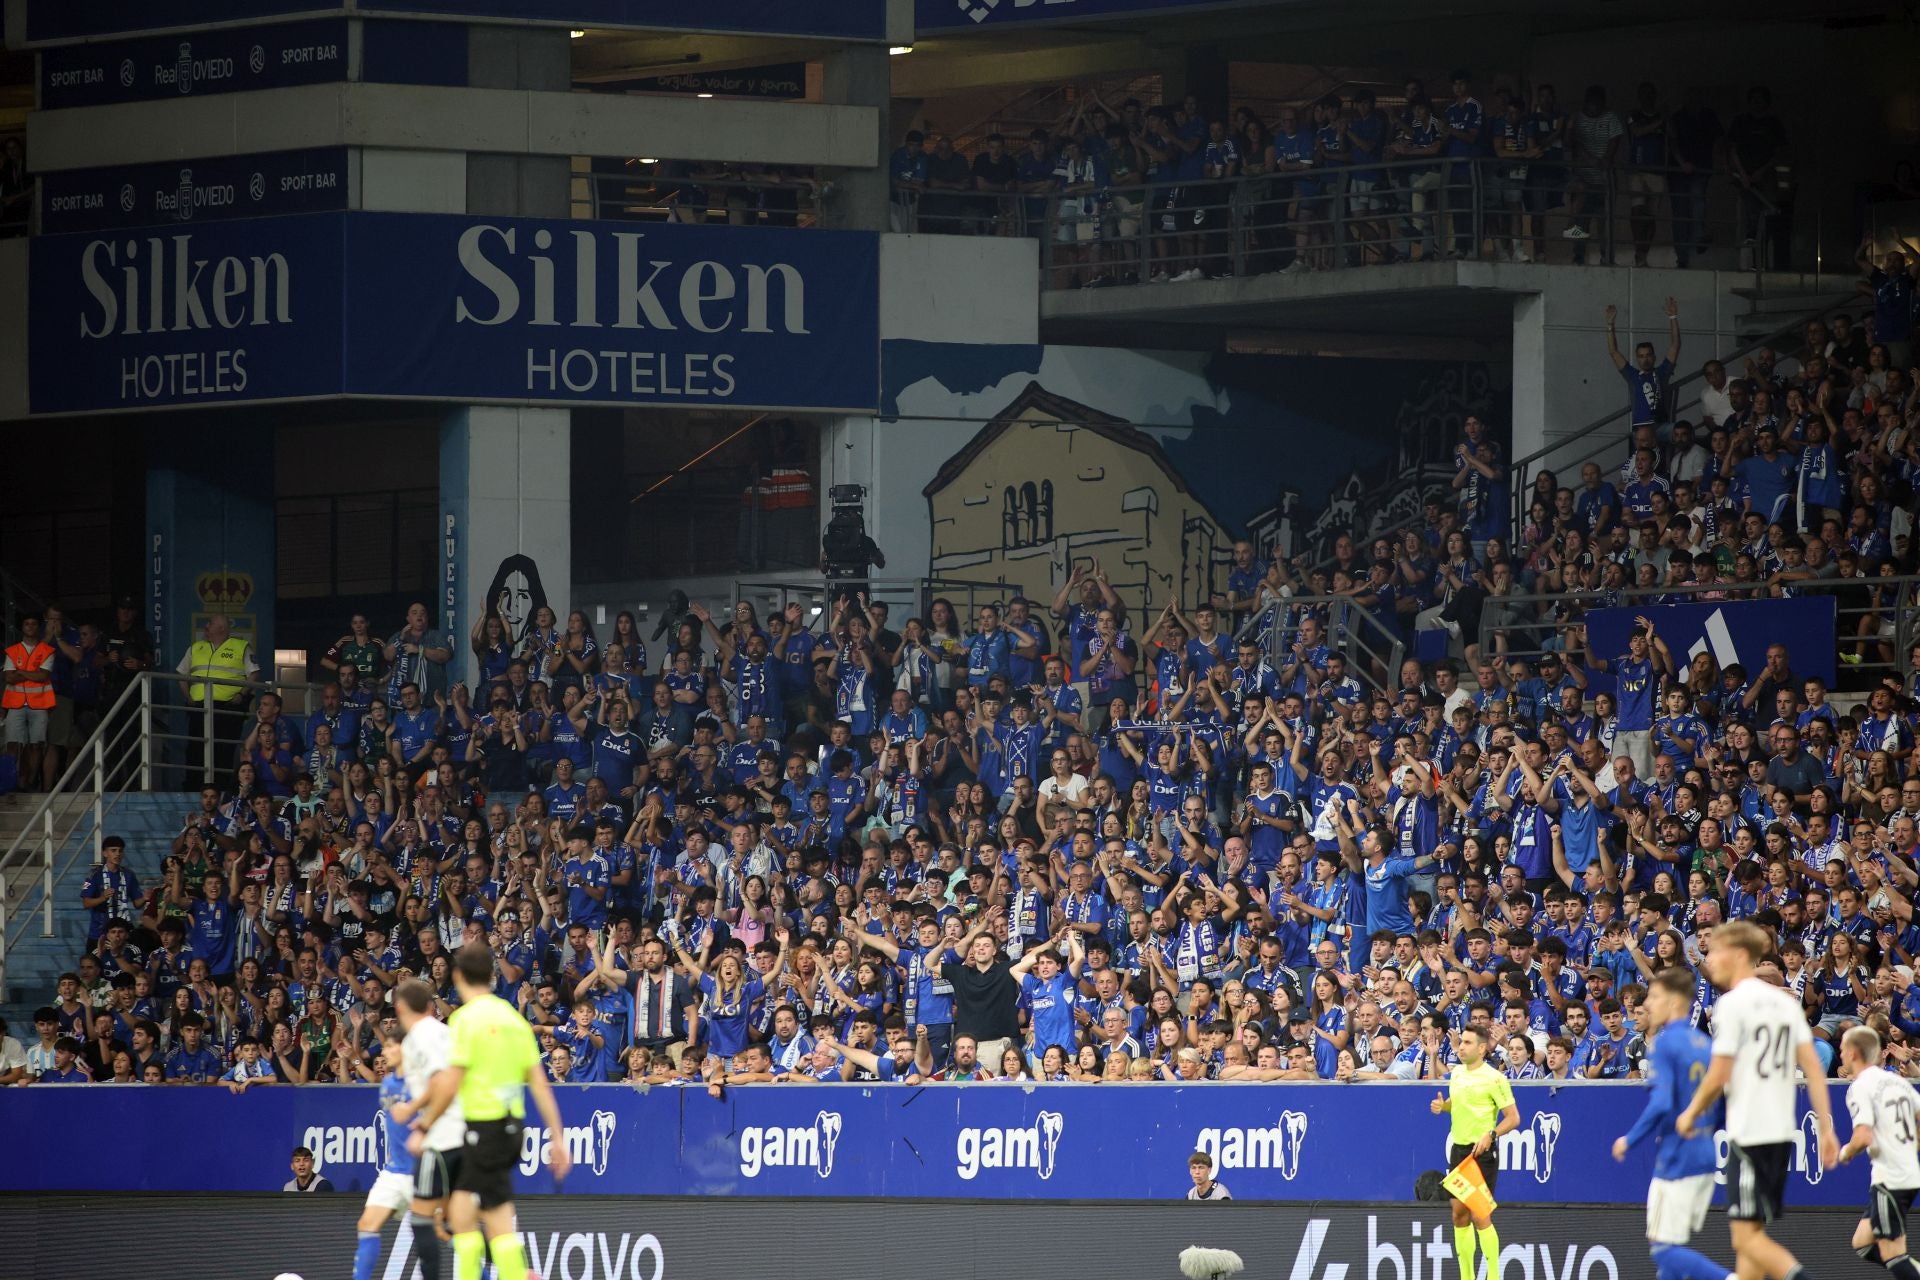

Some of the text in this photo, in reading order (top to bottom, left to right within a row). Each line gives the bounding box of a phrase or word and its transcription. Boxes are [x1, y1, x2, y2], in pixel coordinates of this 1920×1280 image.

[51, 68, 103, 87] SPORT BAR
[155, 58, 233, 84] Real OVIEDO
[282, 45, 337, 64] SPORT BAR
[706, 76, 741, 90] valor
[748, 80, 755, 91] y
[761, 79, 800, 92] garra
[52, 193, 103, 211] SPORT BAR
[156, 185, 233, 210] Real OVIEDO
[281, 173, 336, 191] SPORT BAR
[81, 235, 292, 339] Silken
[456, 224, 810, 335] Silken
[121, 349, 247, 398] HOTELES
[527, 348, 735, 396] HOTELES
[153, 535, 162, 666] PUESTO
[785, 652, 805, 664] IGI
[1825, 987, 1853, 997] DIGI
[1754, 1024, 1790, 1079] 24
[1885, 1096, 1914, 1145] 30
[303, 1126, 377, 1174] gam
[740, 1127, 819, 1177] gam
[957, 1128, 1038, 1179] gam
[1197, 1127, 1282, 1178] gam
[453, 1215, 664, 1280] vavo
